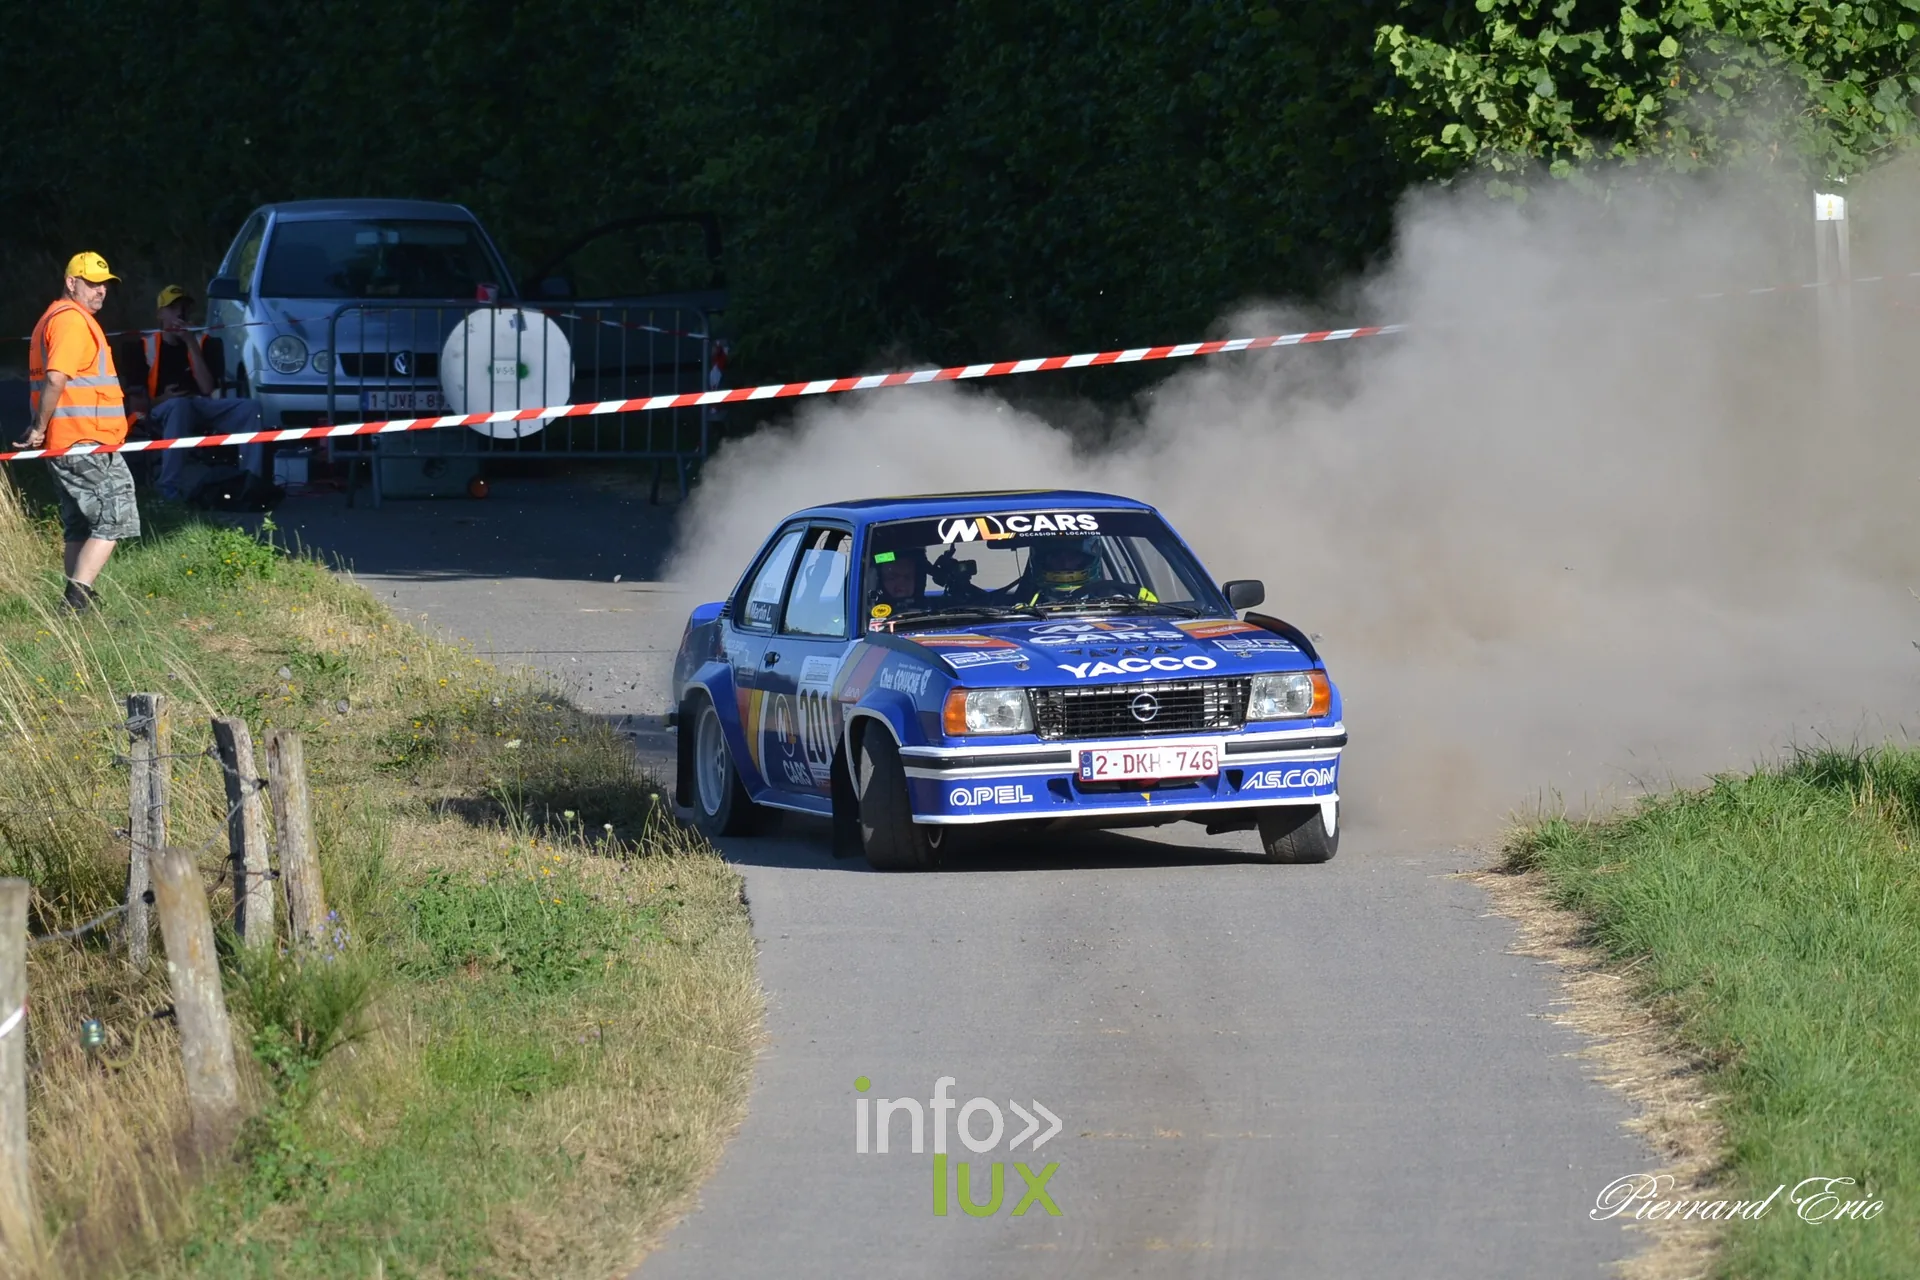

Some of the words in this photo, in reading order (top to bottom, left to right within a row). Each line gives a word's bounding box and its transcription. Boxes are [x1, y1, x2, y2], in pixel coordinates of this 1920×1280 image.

[1006, 514, 1099, 533] CARS
[1029, 630, 1184, 644] CARS
[1057, 655, 1217, 679] YACCO
[800, 688, 836, 765] 201
[782, 759, 812, 786] CARS
[1082, 767, 1091, 777] B
[949, 784, 1034, 806] OPEL
